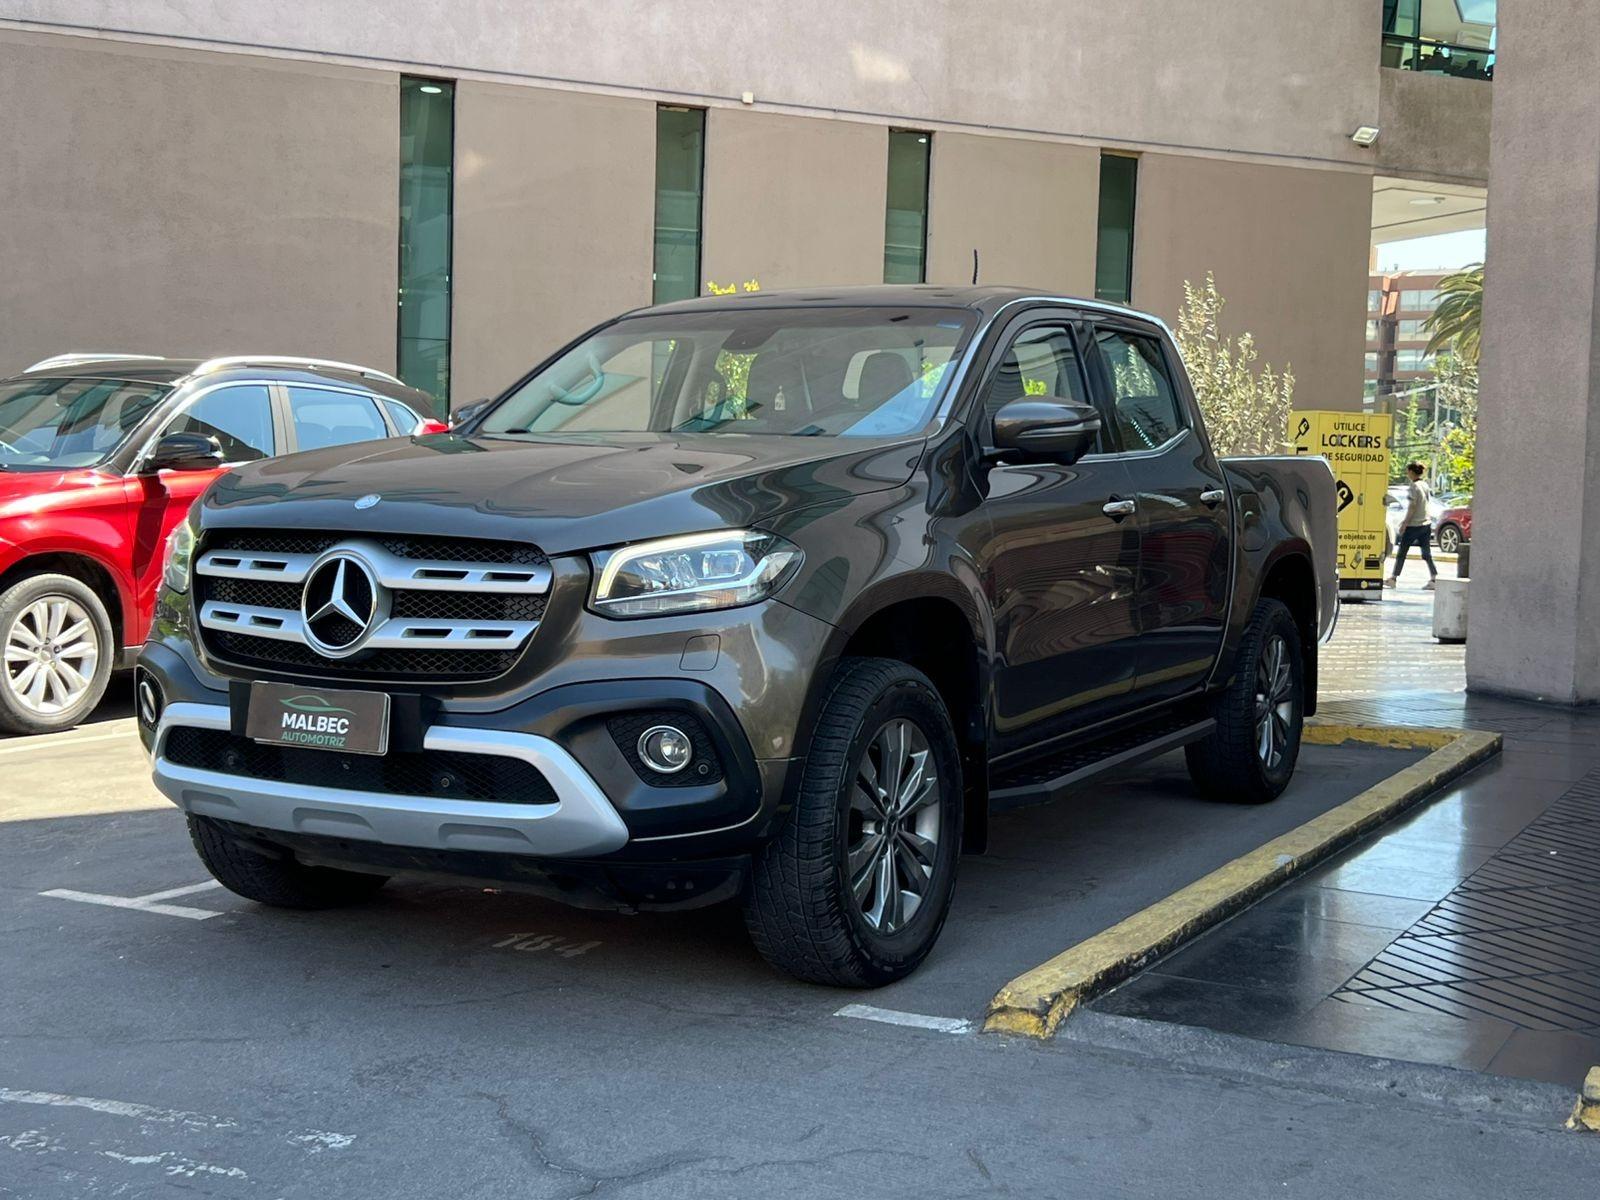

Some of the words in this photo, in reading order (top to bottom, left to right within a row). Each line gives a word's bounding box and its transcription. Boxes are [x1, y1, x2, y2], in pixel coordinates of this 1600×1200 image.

[1333, 422, 1366, 432] UTILICE
[1321, 434, 1381, 449] LOCKERS
[1335, 453, 1384, 463] SEGURIDAD
[1343, 533, 1367, 541] objetos
[281, 712, 350, 734] MALBEC
[281, 731, 346, 747] AUTOMOTRIZ
